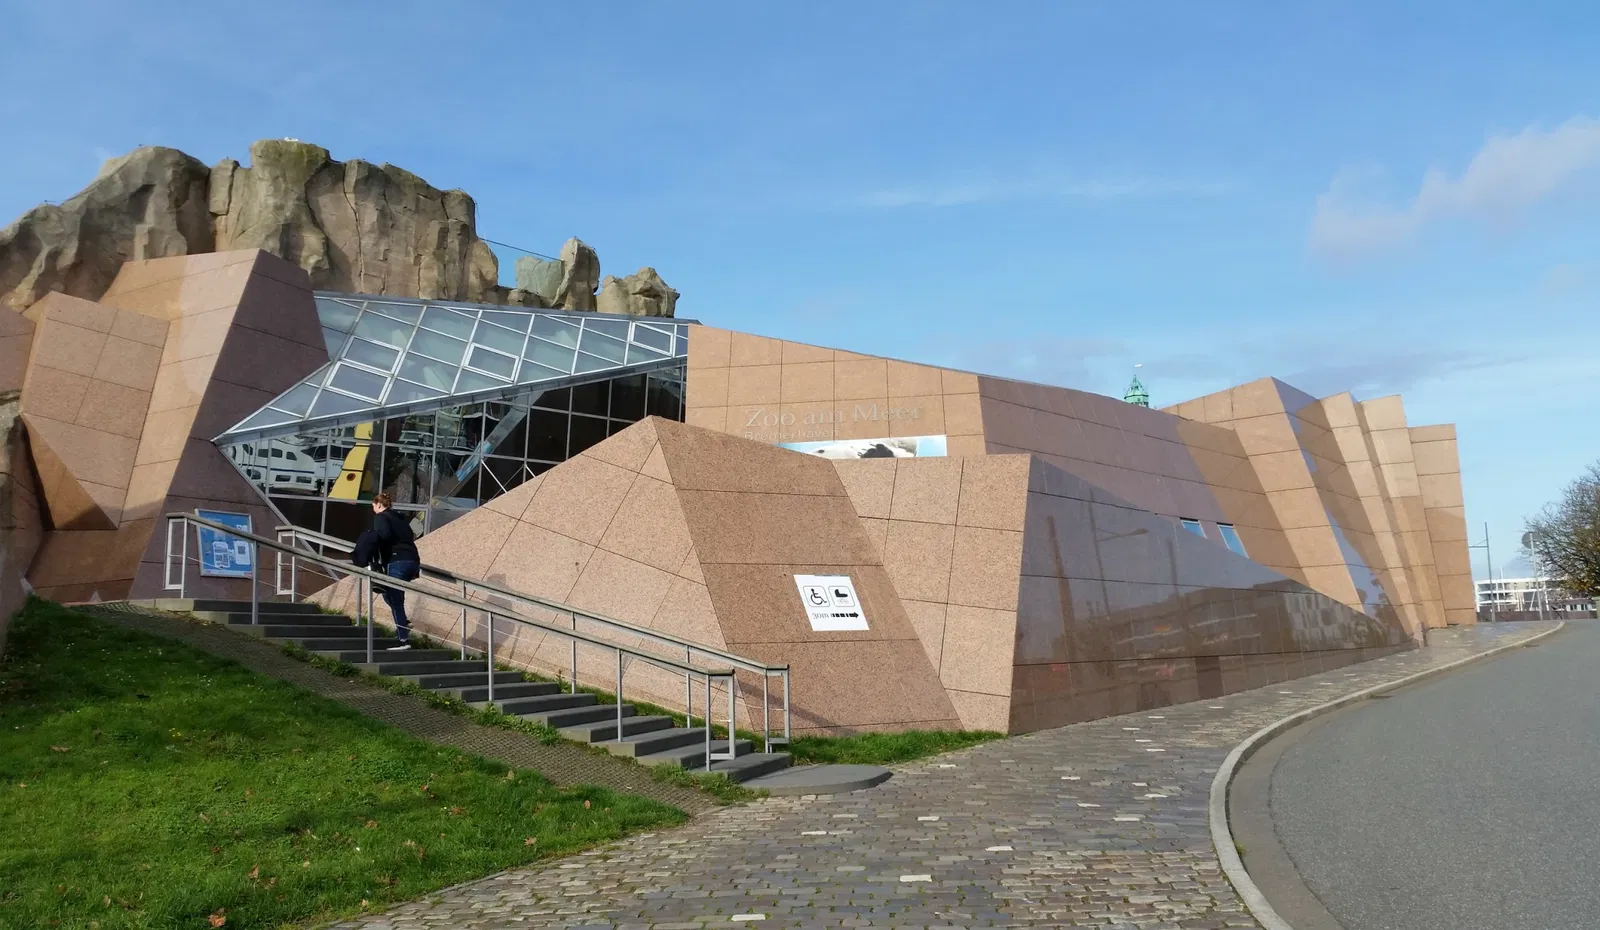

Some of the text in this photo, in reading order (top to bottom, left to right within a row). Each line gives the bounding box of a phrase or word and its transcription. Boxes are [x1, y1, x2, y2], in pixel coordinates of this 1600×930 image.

[744, 403, 922, 427] Zoo am Meer
[744, 429, 839, 442] Bremerhaven
